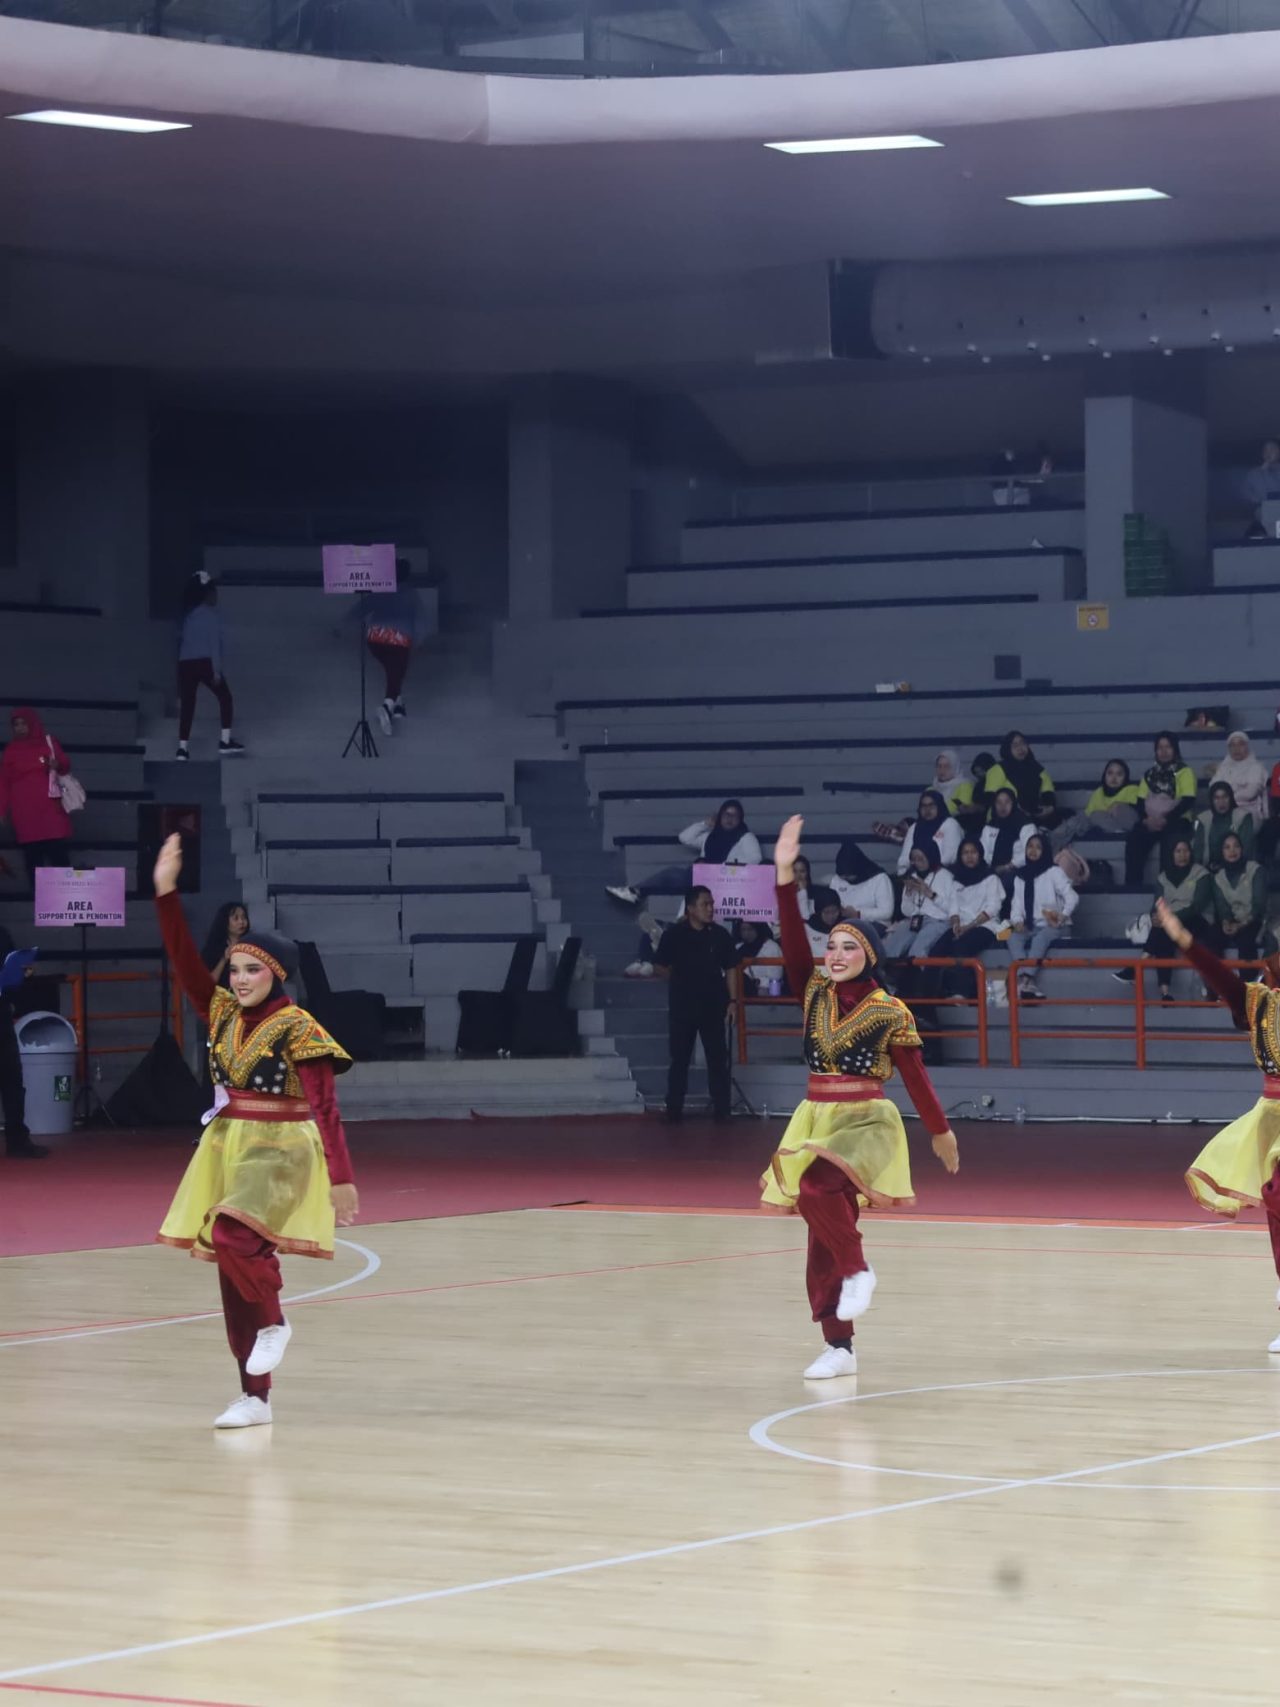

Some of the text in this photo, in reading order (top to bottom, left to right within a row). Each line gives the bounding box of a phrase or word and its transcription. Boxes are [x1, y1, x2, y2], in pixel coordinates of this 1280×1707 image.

[349, 572, 371, 580] AREA
[67, 901, 93, 911] AREA
[721, 897, 746, 907] AREA
[38, 912, 77, 920] SUPPORTER
[86, 912, 122, 920] PENONTON
